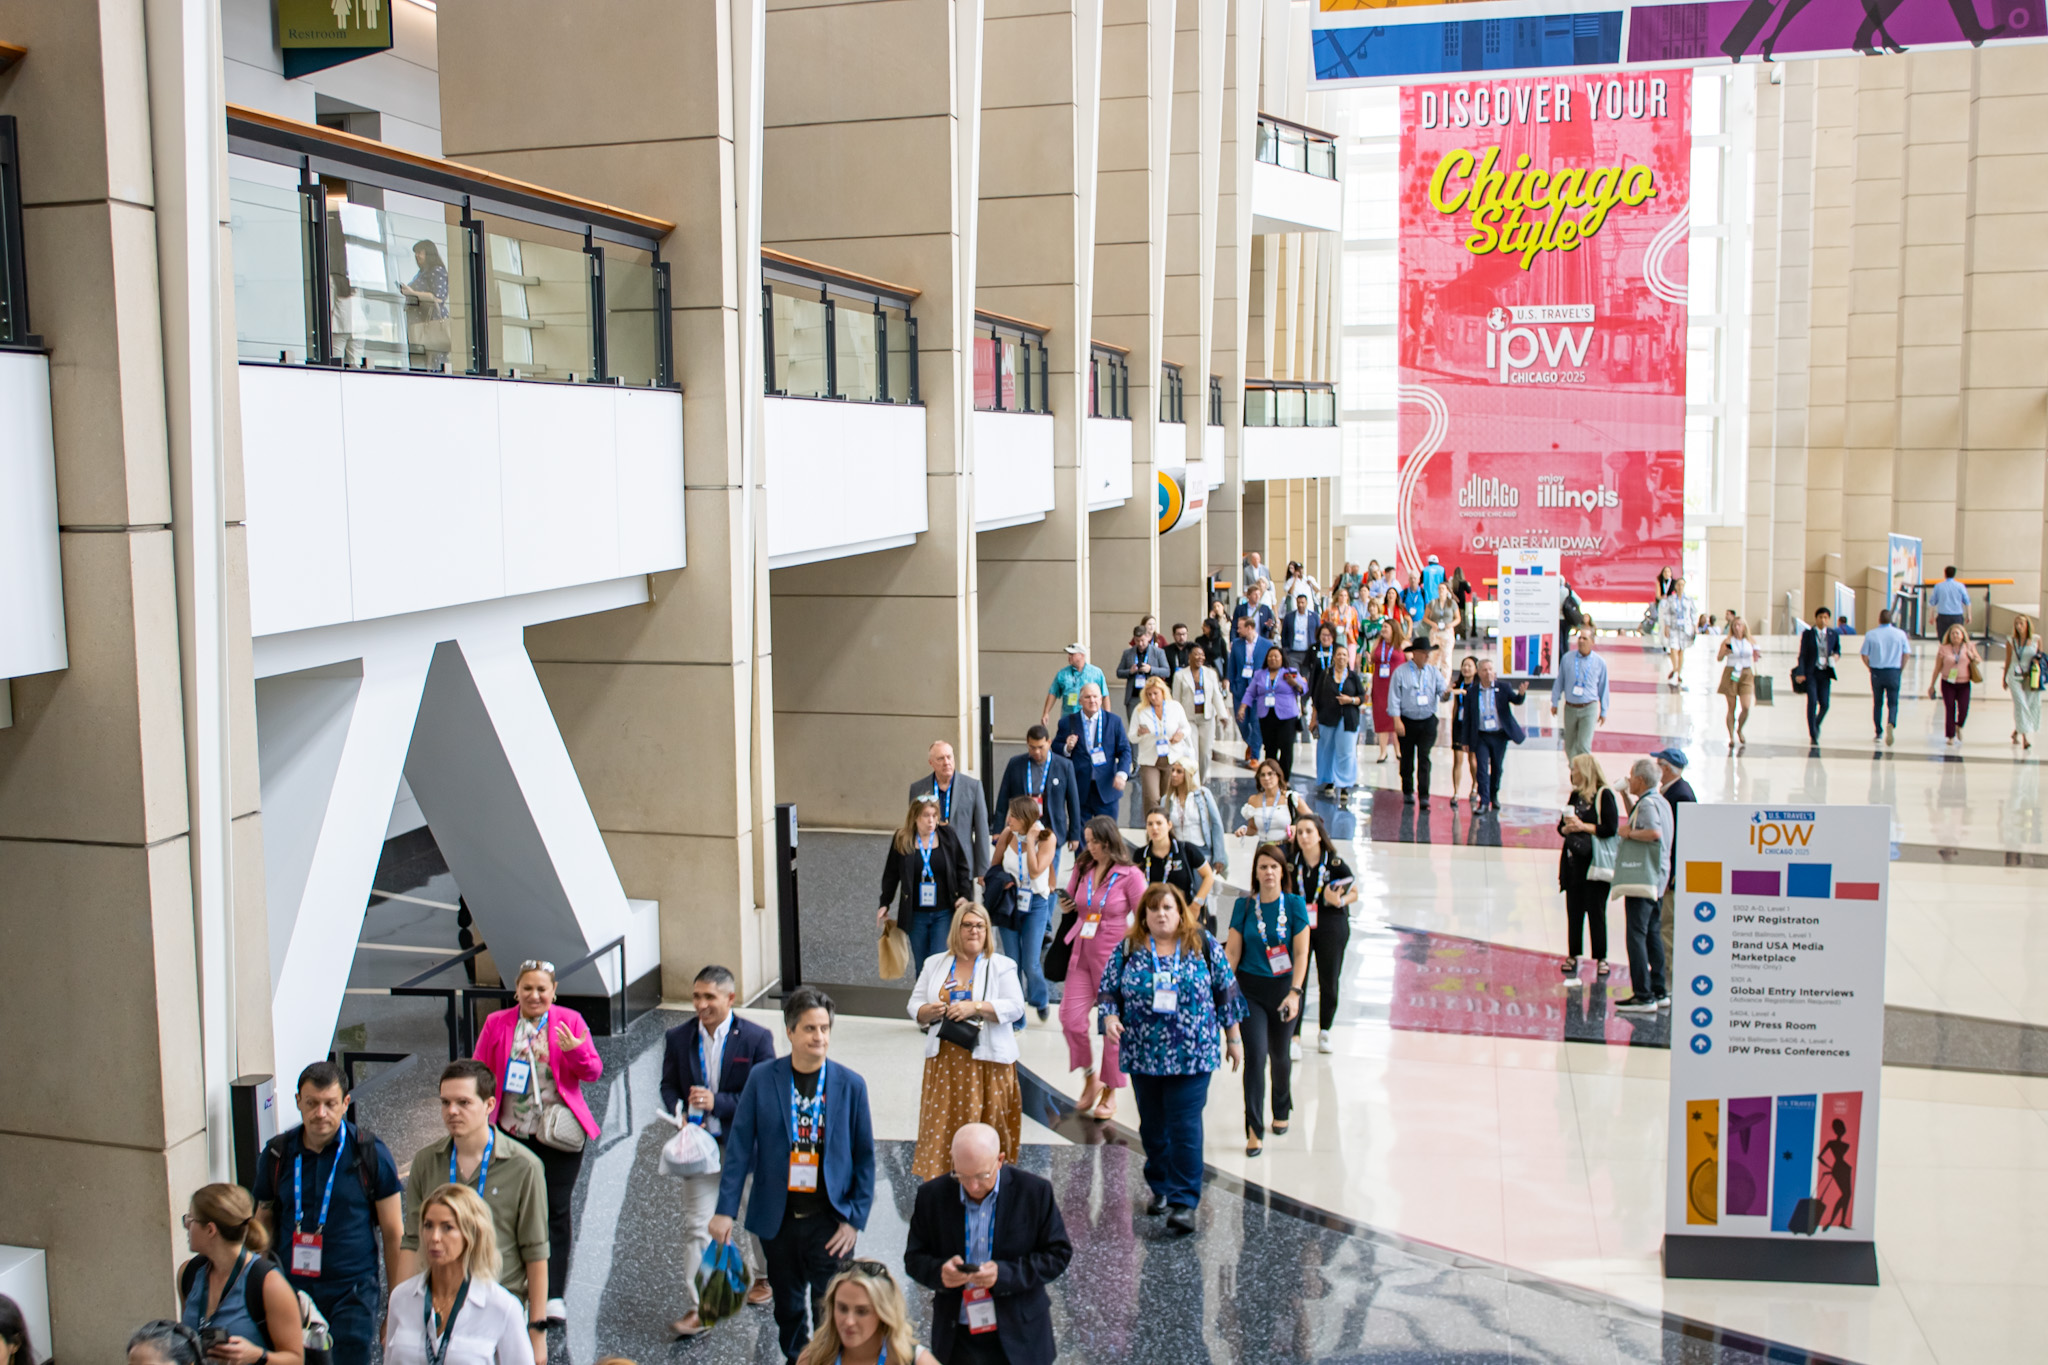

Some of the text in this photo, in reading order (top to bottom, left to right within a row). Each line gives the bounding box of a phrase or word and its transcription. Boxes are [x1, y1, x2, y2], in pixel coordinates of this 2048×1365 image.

[288, 28, 347, 40] Restroom
[1421, 78, 1668, 129] DISCOVER YOUR
[1429, 146, 1658, 238] Chicago
[1465, 203, 1581, 271] Style
[1517, 308, 1591, 320] U.S. TRAVEL'S
[1511, 371, 1586, 383] CHICAGO 2025
[1537, 475, 1564, 484] enjoy
[1458, 473, 1519, 508] CHICAGO
[1537, 485, 1619, 513] illinois
[1472, 536, 1603, 549] O'HARE & MIDWAY
[1783, 812, 1813, 820] TRAVEL'S
[1732, 915, 1819, 925] IPW Registraton
[1732, 940, 1824, 951] Brand USA Media
[1731, 953, 1796, 963] Marketplace
[1730, 986, 1854, 997] Global Entry Interviews
[1729, 1020, 1816, 1030] IPW Press Room
[1728, 1046, 1850, 1057] IPW Press Conferences
